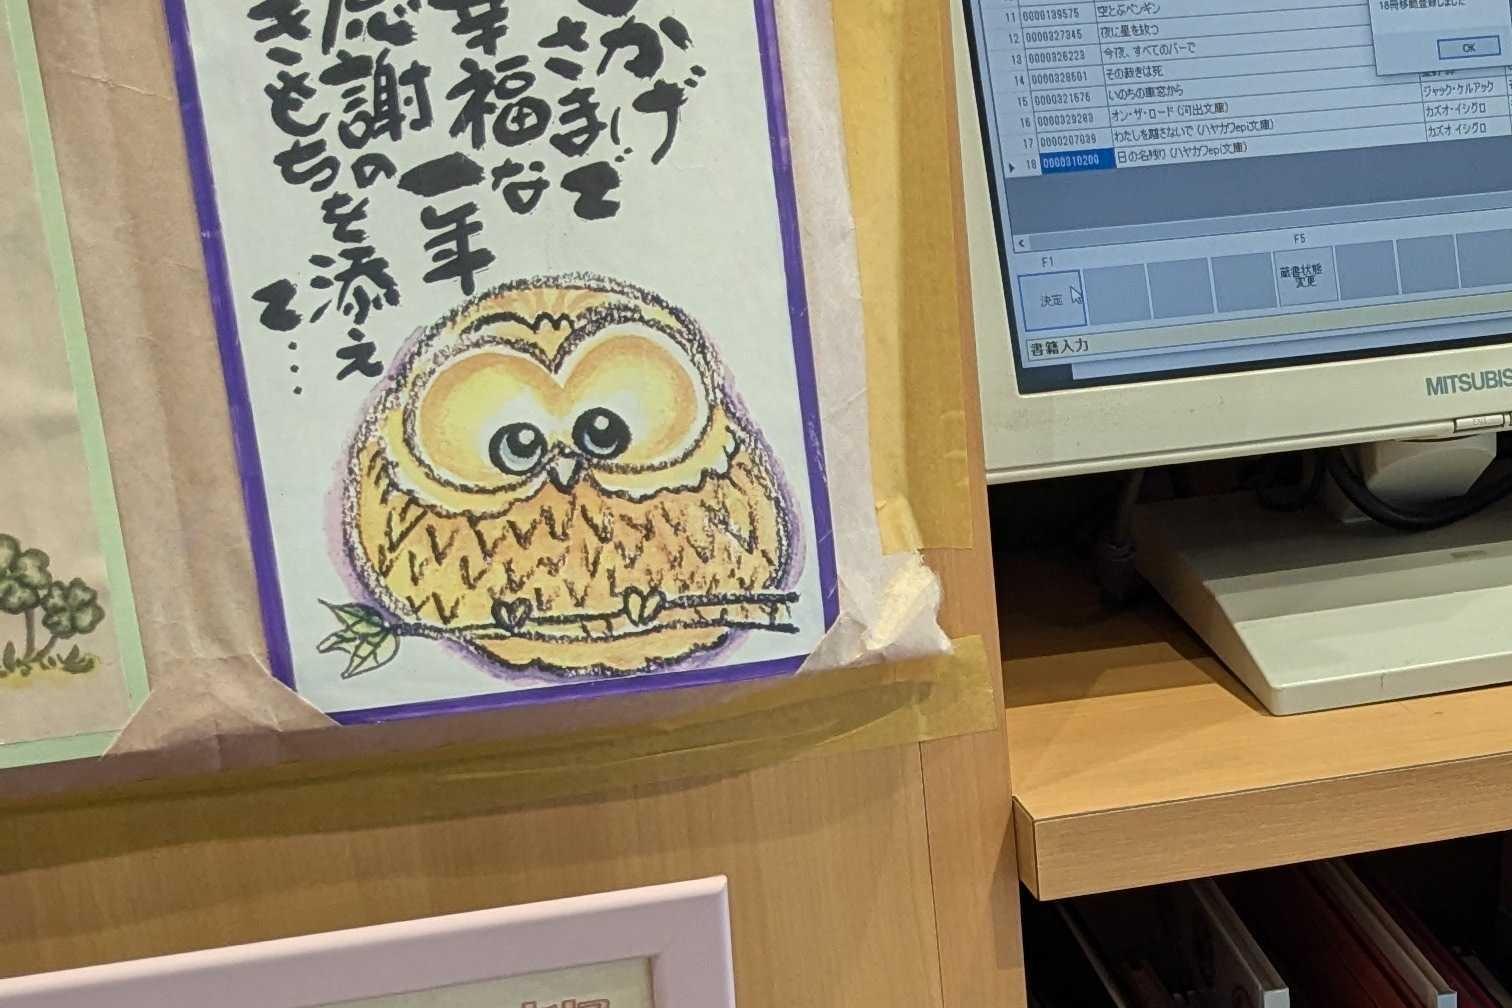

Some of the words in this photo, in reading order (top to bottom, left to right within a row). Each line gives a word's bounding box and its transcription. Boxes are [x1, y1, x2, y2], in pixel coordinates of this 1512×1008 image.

[1462, 43, 1476, 52] OK
[579, 0, 705, 165] かげ
[1426, 102, 1486, 118] カズオ・イシグロ
[538, 17, 632, 221] さまで
[397, 152, 496, 296] 一年
[1294, 233, 1306, 244] F5
[1041, 257, 1054, 267] F1
[1040, 293, 1064, 307] 決定
[1030, 338, 1089, 357] 書籍入力
